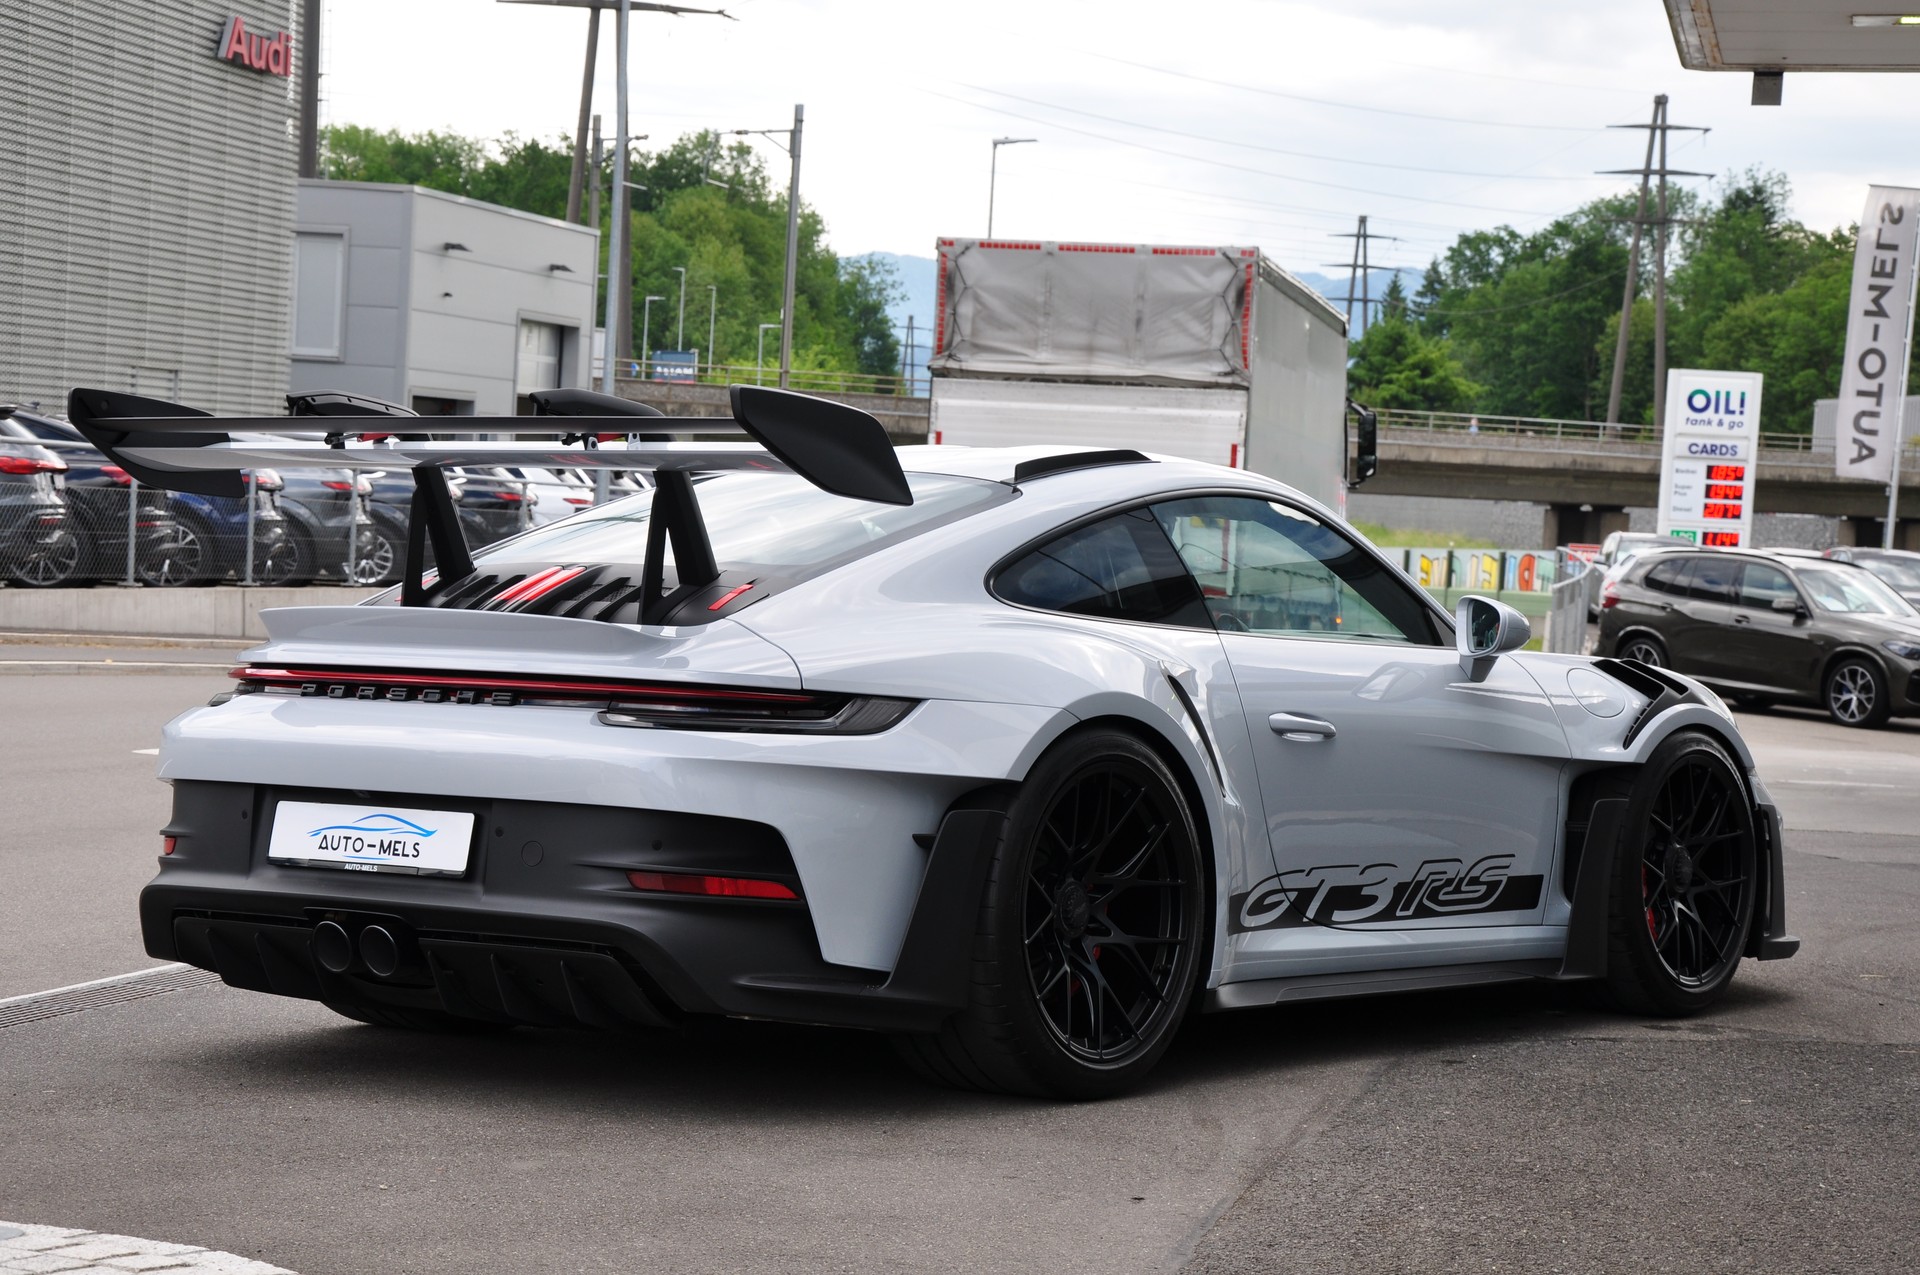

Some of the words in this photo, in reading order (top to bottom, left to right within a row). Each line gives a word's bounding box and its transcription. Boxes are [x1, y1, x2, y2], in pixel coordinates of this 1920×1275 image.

[224, 15, 293, 77] Audi
[1687, 388, 1746, 415] OIL!
[1685, 417, 1713, 427] tank
[1716, 418, 1724, 427] &
[1727, 420, 1744, 430] go
[1688, 442, 1738, 456] CARDS
[300, 683, 518, 706] PORSCHE
[318, 834, 420, 858] AUTO-MELS
[344, 863, 378, 872] AUTO-MELS
[1239, 862, 1398, 928] GT3
[1396, 853, 1515, 917] RS
